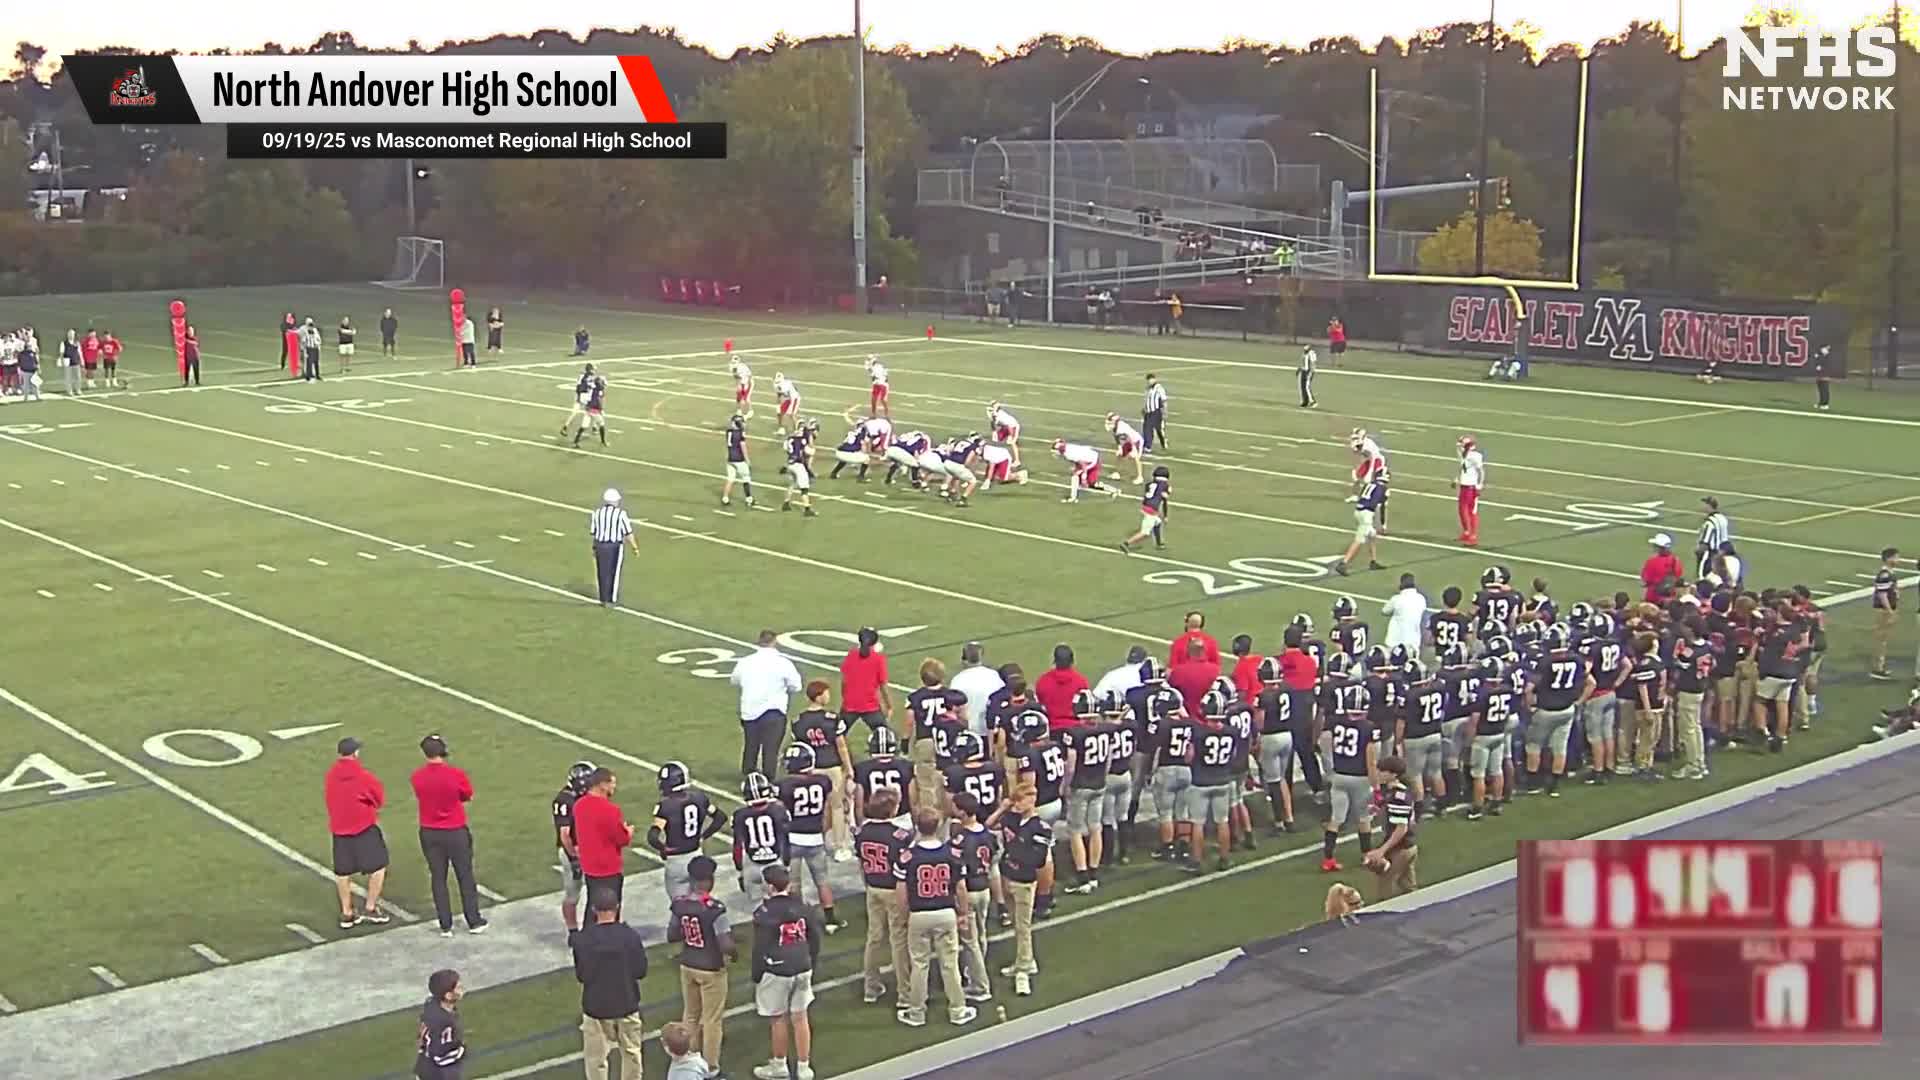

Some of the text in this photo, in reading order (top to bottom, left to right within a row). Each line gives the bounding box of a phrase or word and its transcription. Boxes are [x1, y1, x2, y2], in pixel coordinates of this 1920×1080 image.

[1586, 298, 1653, 361] NA
[1660, 309, 1810, 366] KNIGHTS
[1143, 557, 1328, 596] 20
[1487, 599, 1509, 620] 13
[1436, 621, 1460, 647] 33
[1601, 645, 1621, 672] 82
[1551, 662, 1578, 689] 77
[1279, 693, 1291, 721] 2
[1419, 692, 1442, 722] 72
[1487, 694, 1512, 722] 25
[1084, 733, 1109, 765] 20
[1204, 736, 1235, 765] 32
[1334, 725, 1359, 757] 23
[793, 784, 824, 817] 29
[684, 804, 698, 837] 8
[744, 815, 777, 849] 10
[861, 841, 889, 874] 55
[917, 864, 950, 898] 88
